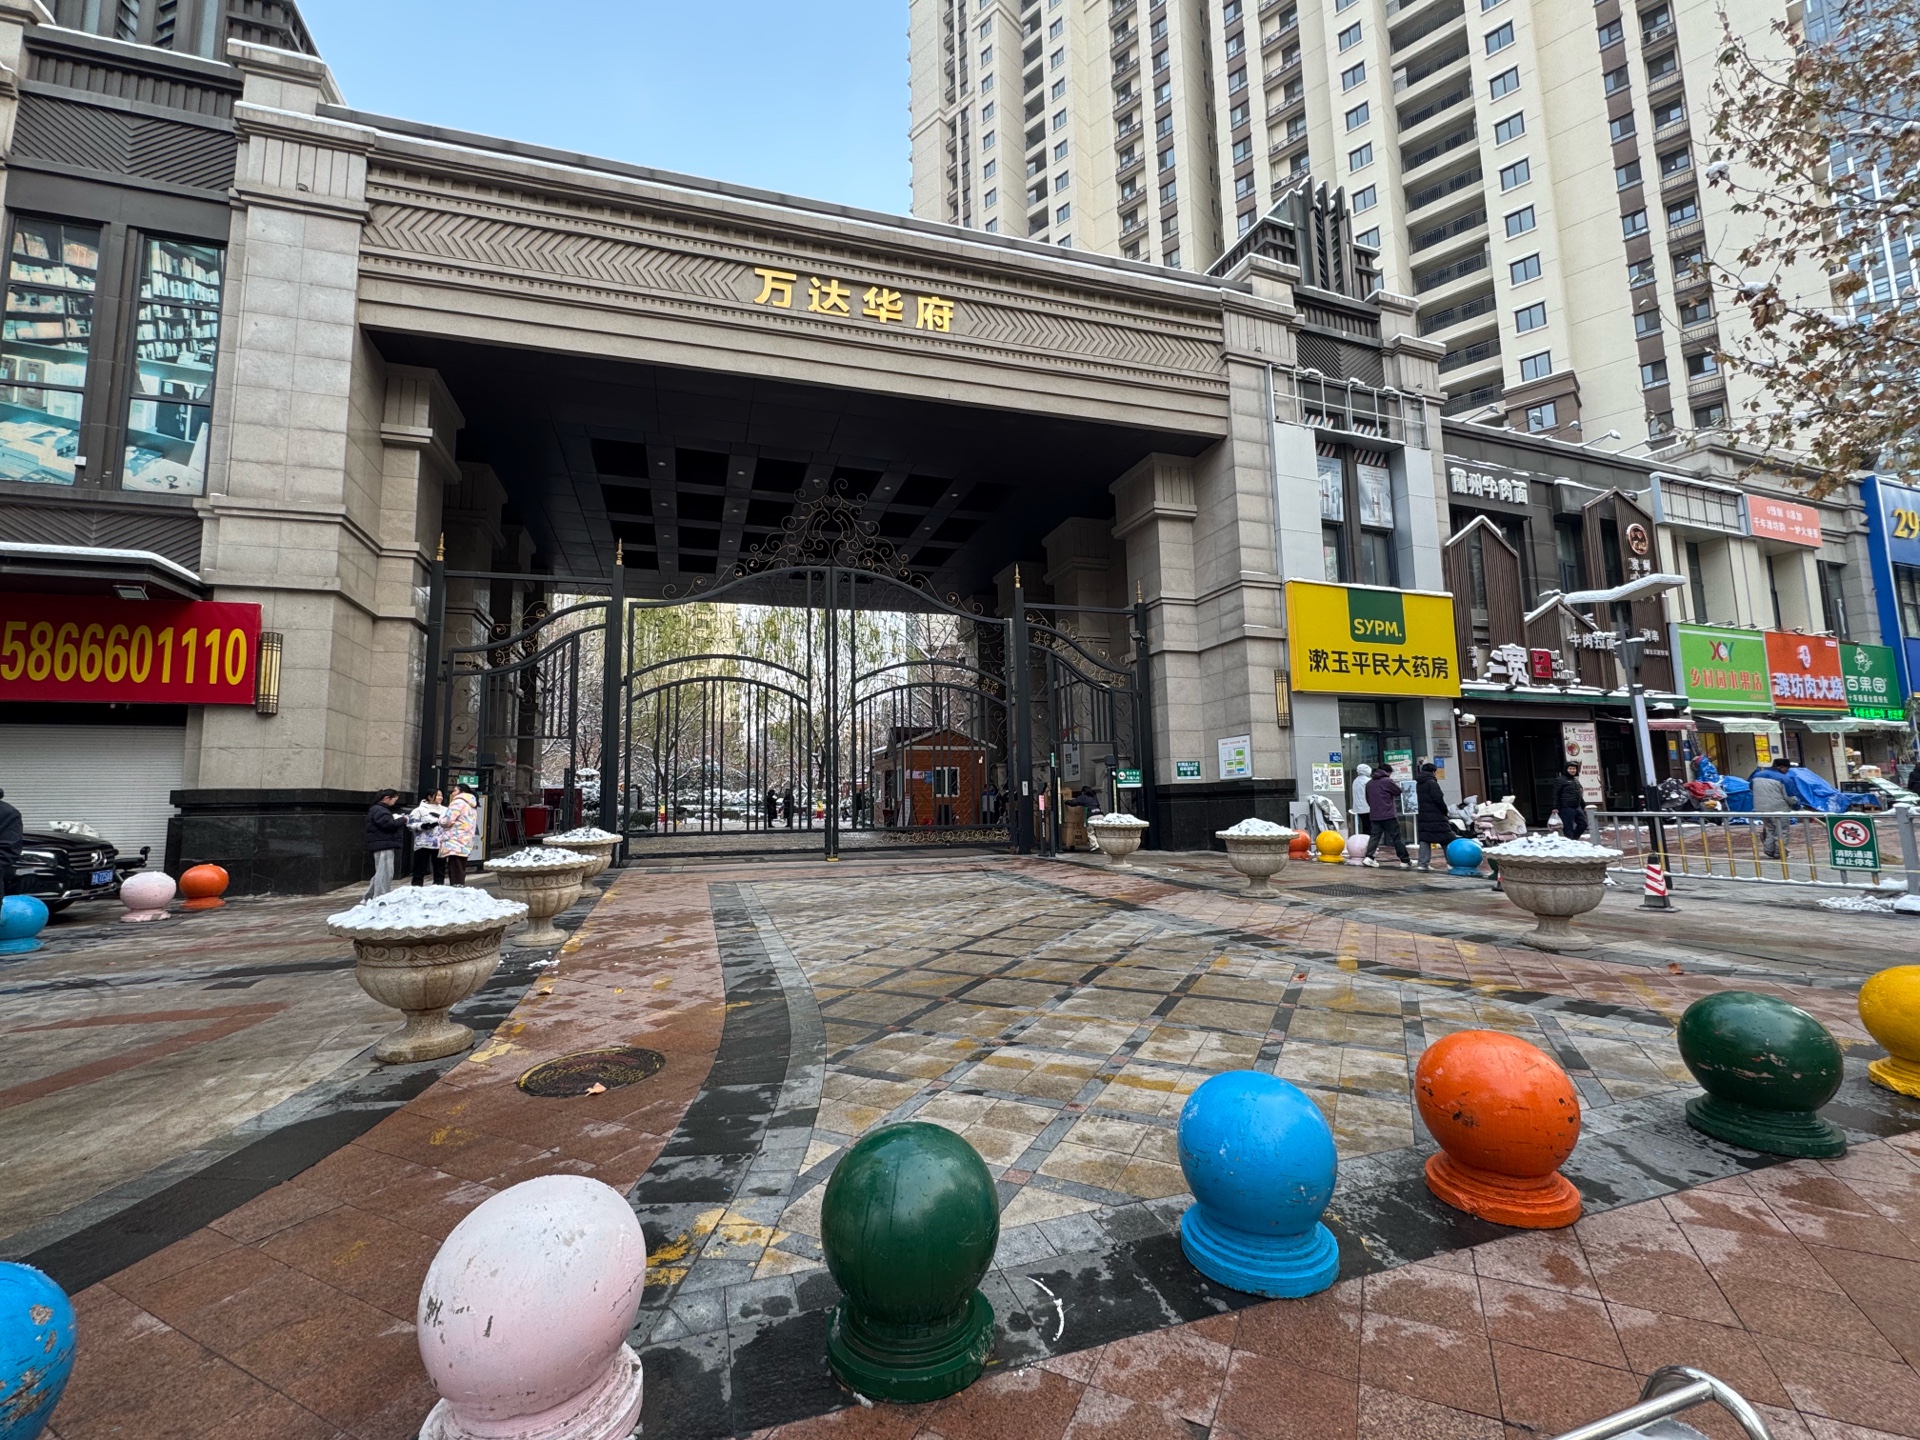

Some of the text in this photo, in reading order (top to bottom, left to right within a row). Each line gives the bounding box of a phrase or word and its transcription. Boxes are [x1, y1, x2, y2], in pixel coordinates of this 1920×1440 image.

[754, 268, 954, 333] 万达华府
[1567, 631, 1617, 650] 牛肉拉面
[1, 621, 248, 686] 5866601110
[1308, 648, 1449, 680] 漱玉平民大药房
[1690, 667, 1763, 691] 乡村园水果店
[1771, 672, 1845, 700] 潍坊肉火烧
[1845, 674, 1886, 693] 百果园
[1835, 850, 1873, 858] 消防通道
[1836, 857, 1875, 867] 禁止停车
